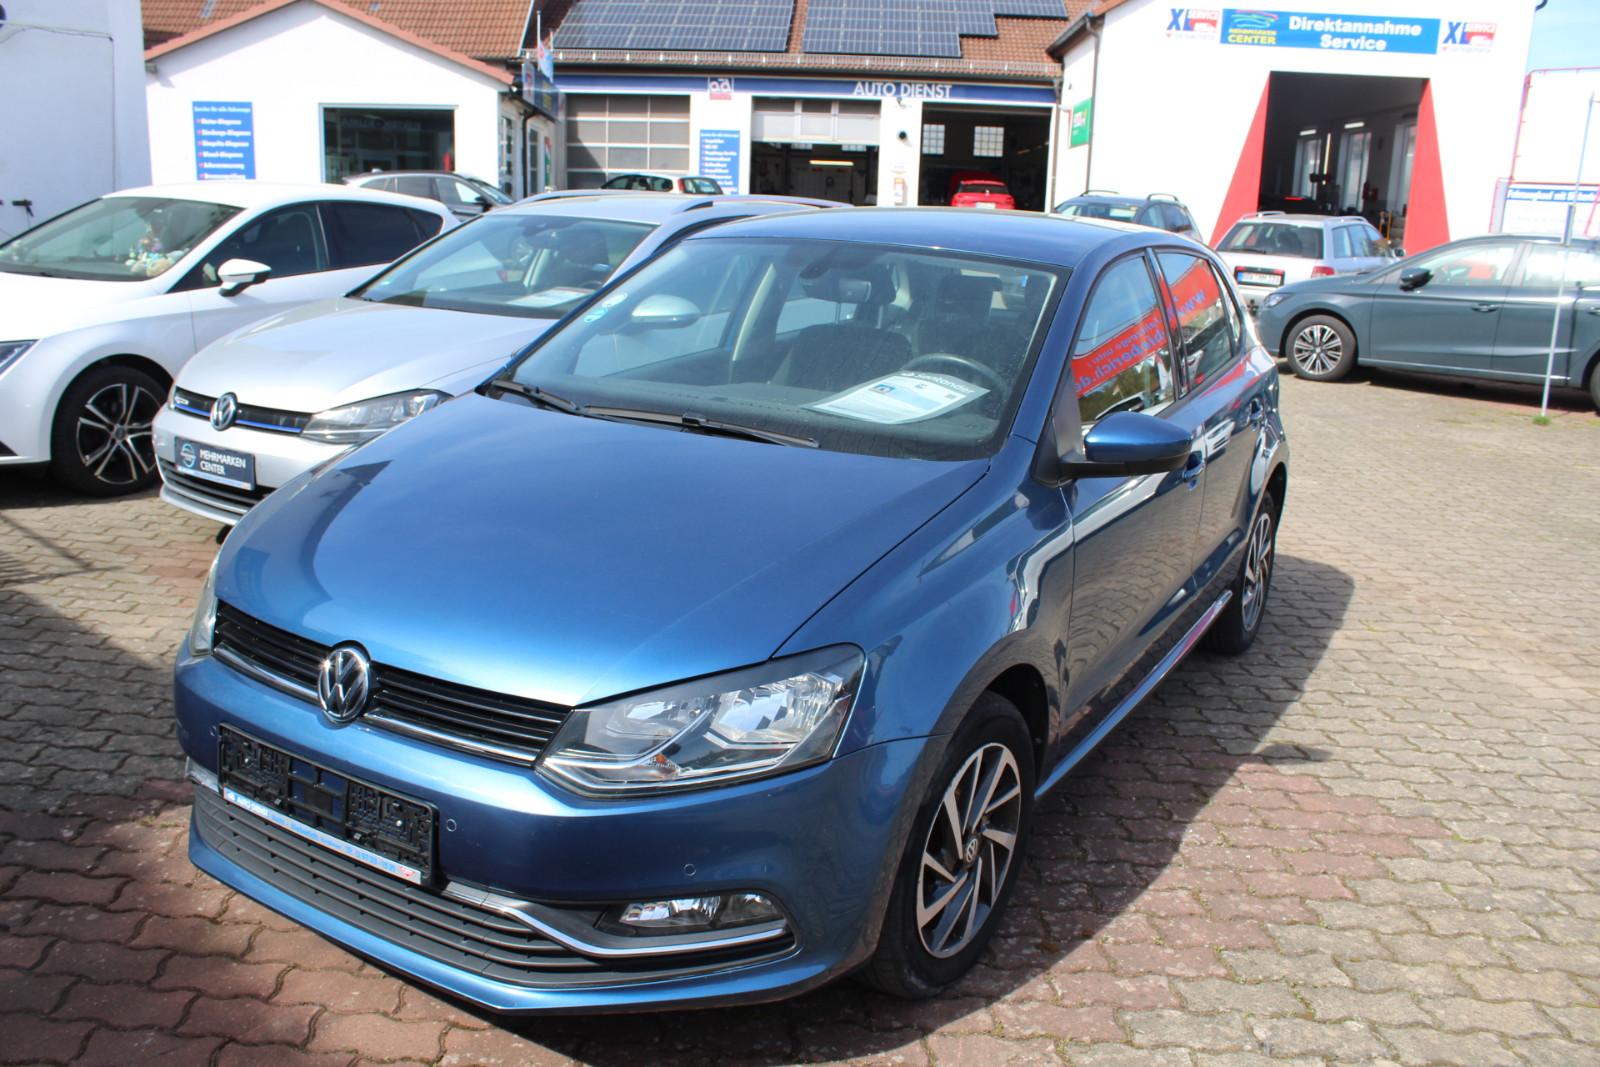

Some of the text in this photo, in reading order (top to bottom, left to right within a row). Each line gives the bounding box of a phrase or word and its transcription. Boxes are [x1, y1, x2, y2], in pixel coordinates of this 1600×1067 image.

[1288, 15, 1423, 37] Direktannahme
[1228, 34, 1277, 45] CENTER
[1320, 33, 1388, 51] Service
[852, 81, 953, 98] AUTO DIENST
[199, 448, 247, 469] MEHRMARKEN
[199, 460, 226, 475] CENTER
